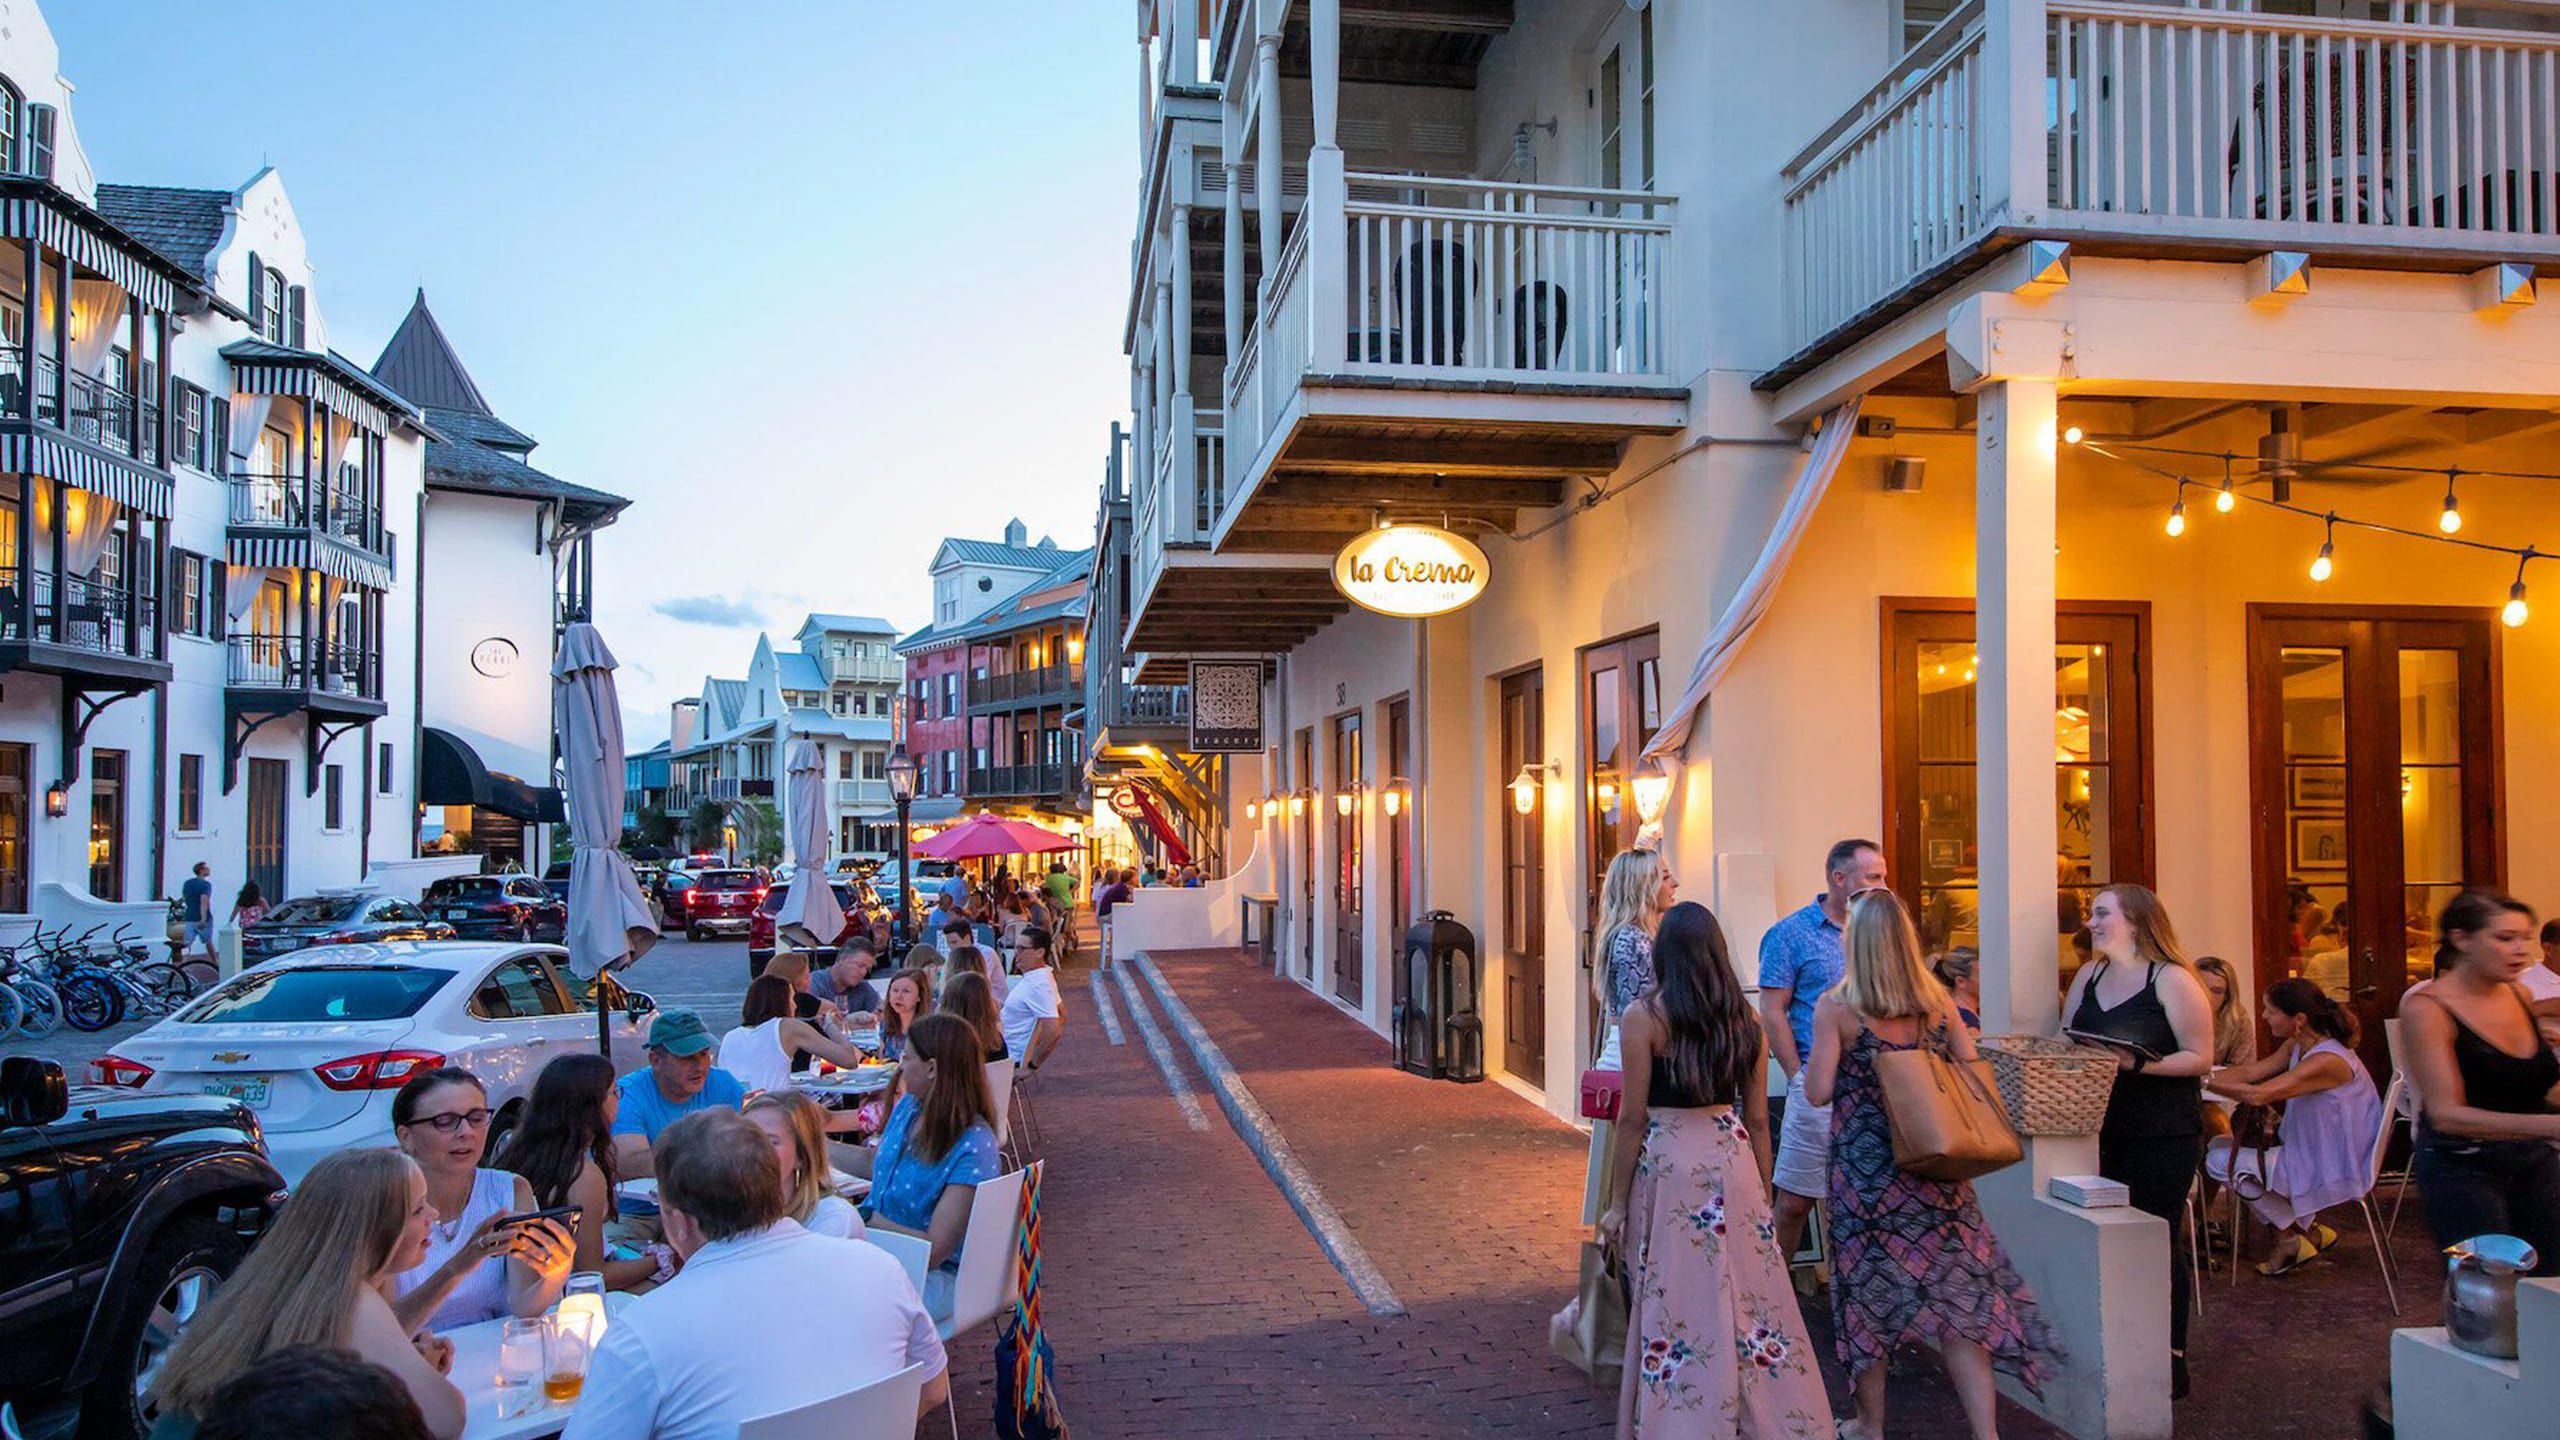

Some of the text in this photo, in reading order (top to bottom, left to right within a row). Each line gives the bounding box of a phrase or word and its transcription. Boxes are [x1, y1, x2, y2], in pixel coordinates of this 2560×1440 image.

[1350, 555, 1476, 584] la Crema
[1336, 682, 1346, 707] 38
[1194, 736, 1260, 748] tracery
